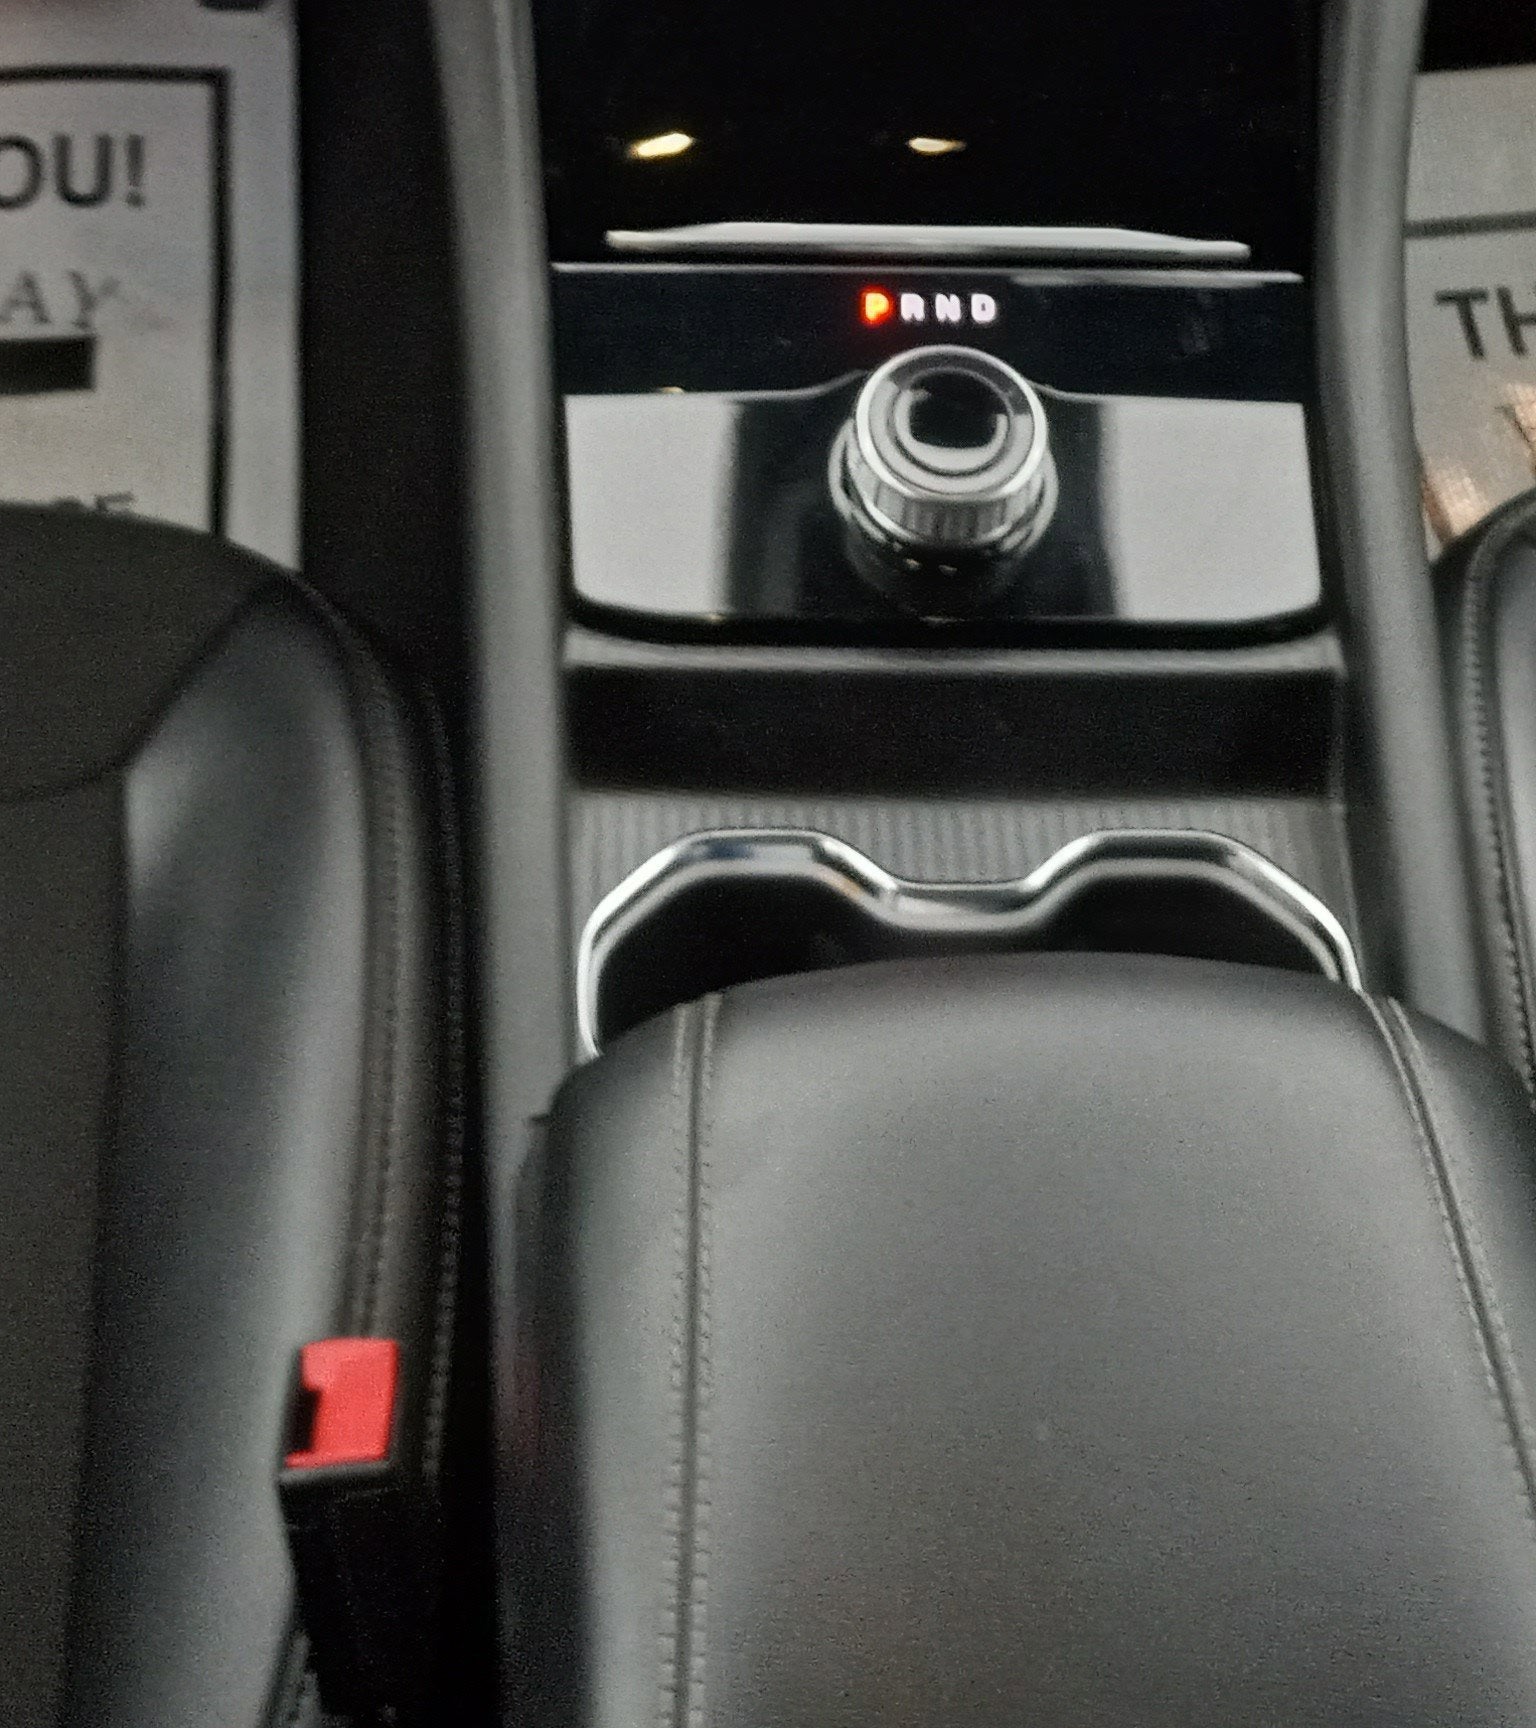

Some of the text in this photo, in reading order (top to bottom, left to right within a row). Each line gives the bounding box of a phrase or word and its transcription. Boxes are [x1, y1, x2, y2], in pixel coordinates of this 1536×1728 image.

[864, 292, 890, 322] P
[934, 292, 962, 323] N
[970, 292, 997, 323] D
